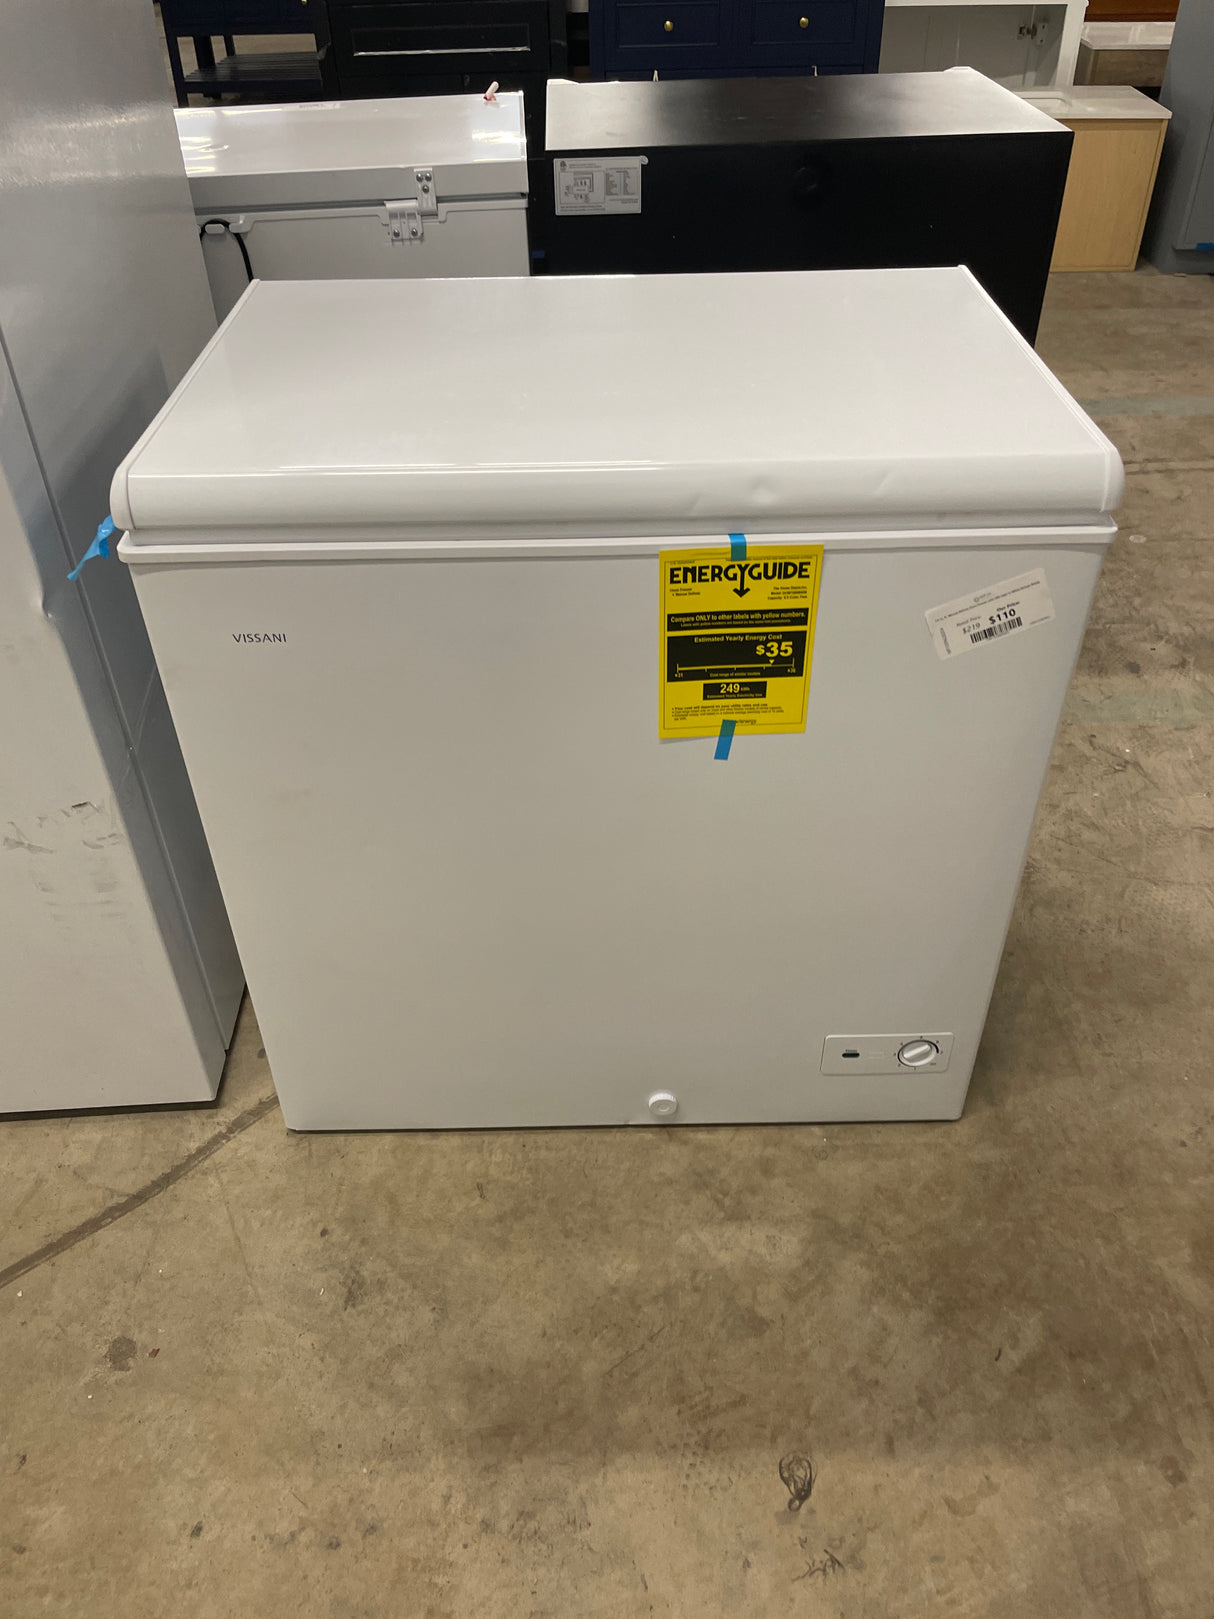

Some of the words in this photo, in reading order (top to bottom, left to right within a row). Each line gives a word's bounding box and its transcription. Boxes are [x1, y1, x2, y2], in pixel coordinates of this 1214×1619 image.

[669, 561, 811, 584] ENERGYGUIDE
[988, 608, 1016, 625] $110
[232, 633, 287, 643] VISSANI
[694, 635, 724, 643] Estimated
[755, 641, 793, 657] $35
[720, 683, 740, 694] 249
